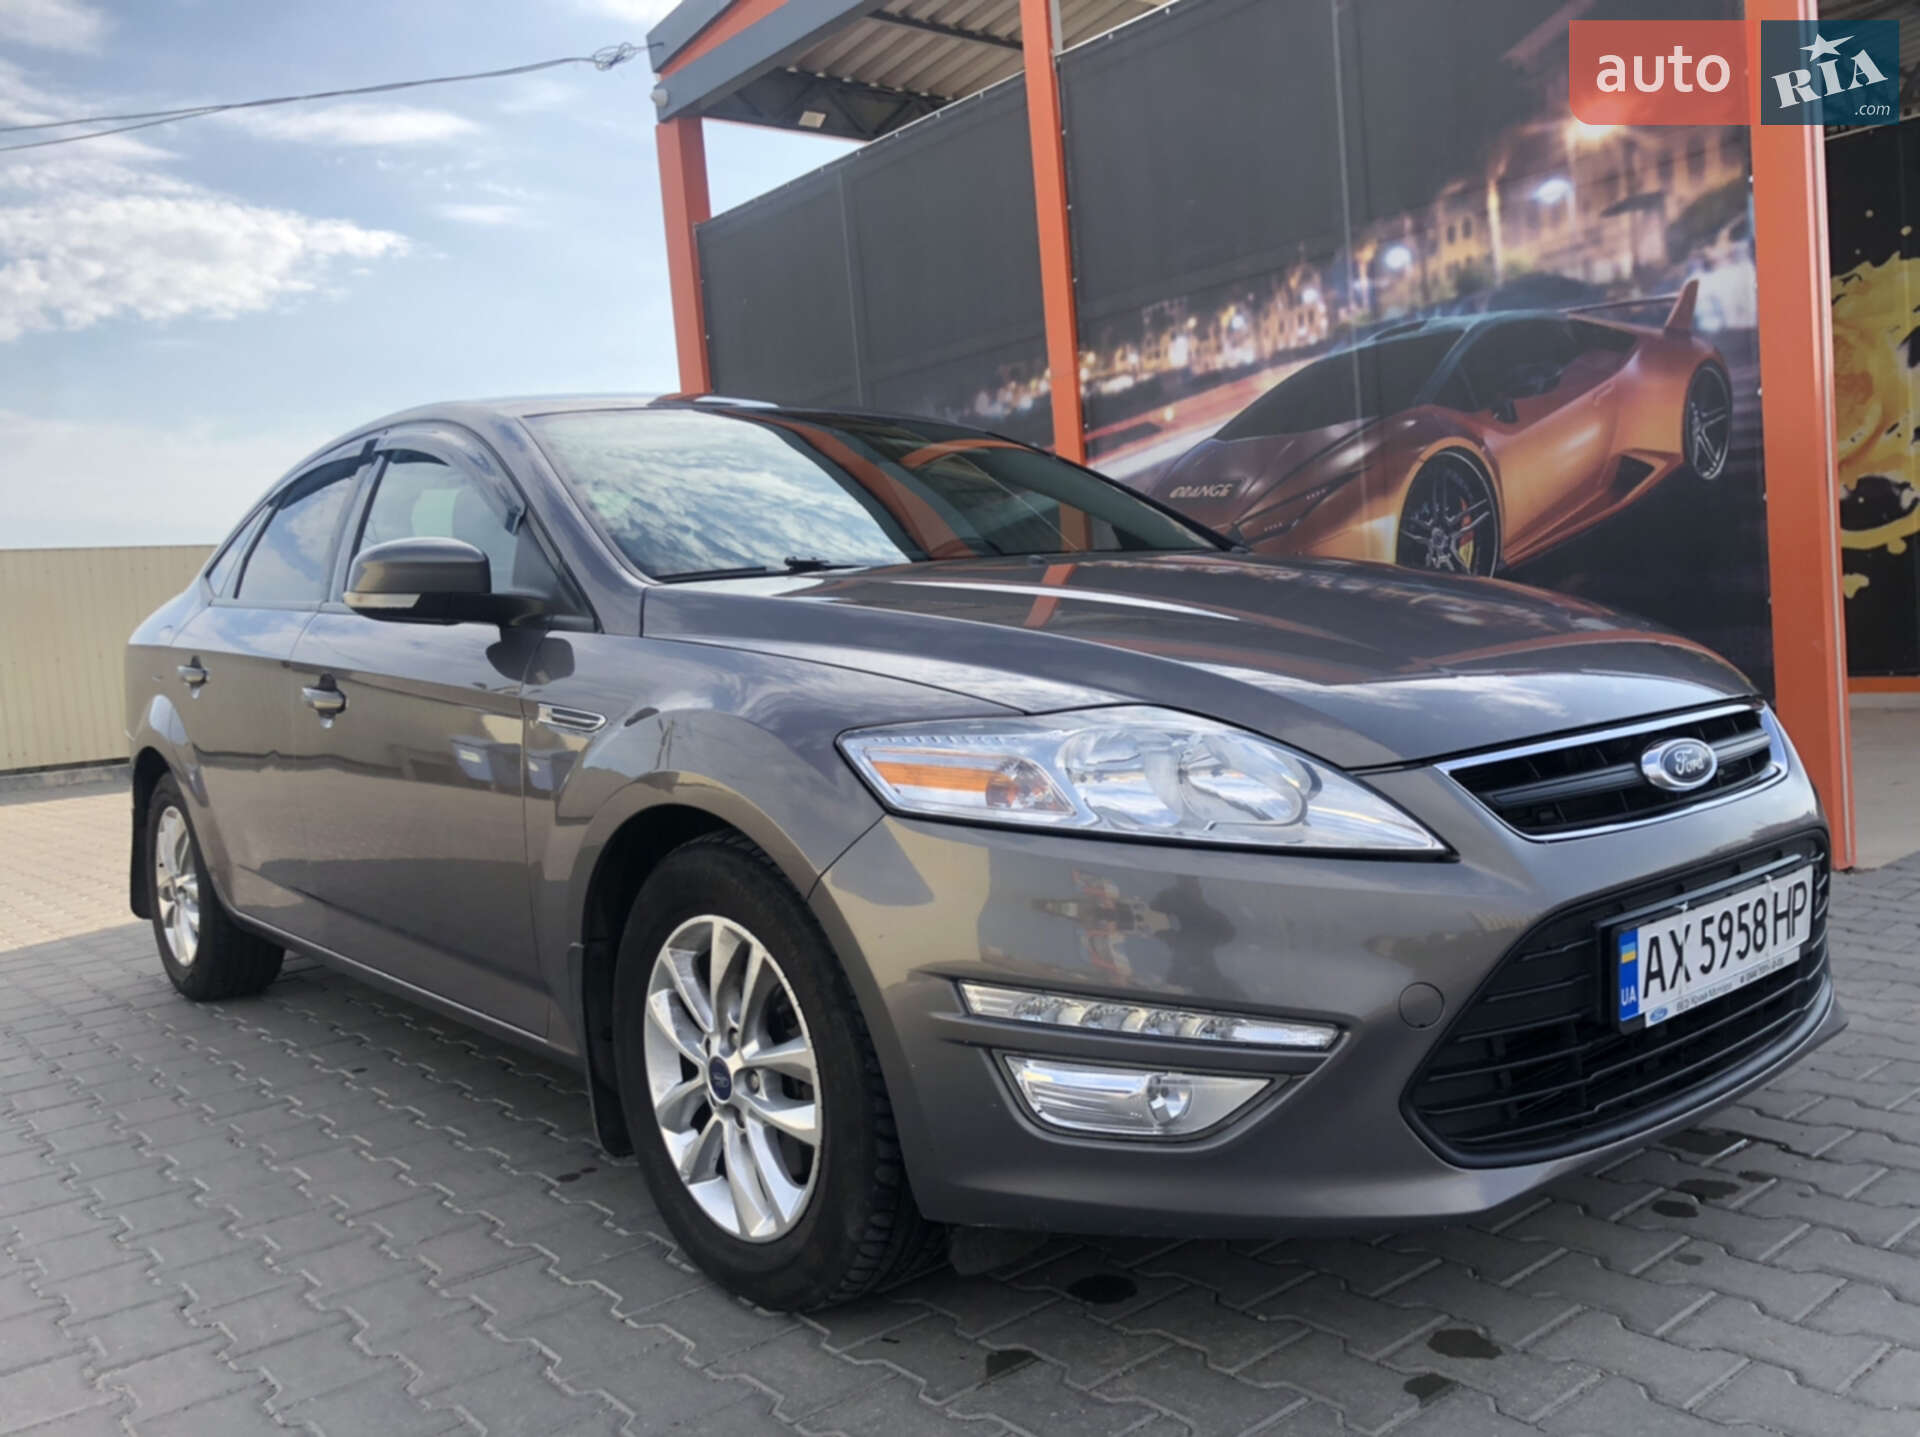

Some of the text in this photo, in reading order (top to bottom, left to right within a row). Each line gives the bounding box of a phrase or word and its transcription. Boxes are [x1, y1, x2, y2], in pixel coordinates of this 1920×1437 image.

[1674, 748, 1704, 775] Ford
[1643, 923, 1691, 999] AX
[1699, 897, 1768, 976] 5958
[1772, 880, 1808, 946] HP
[1620, 987, 1638, 1006] UA
